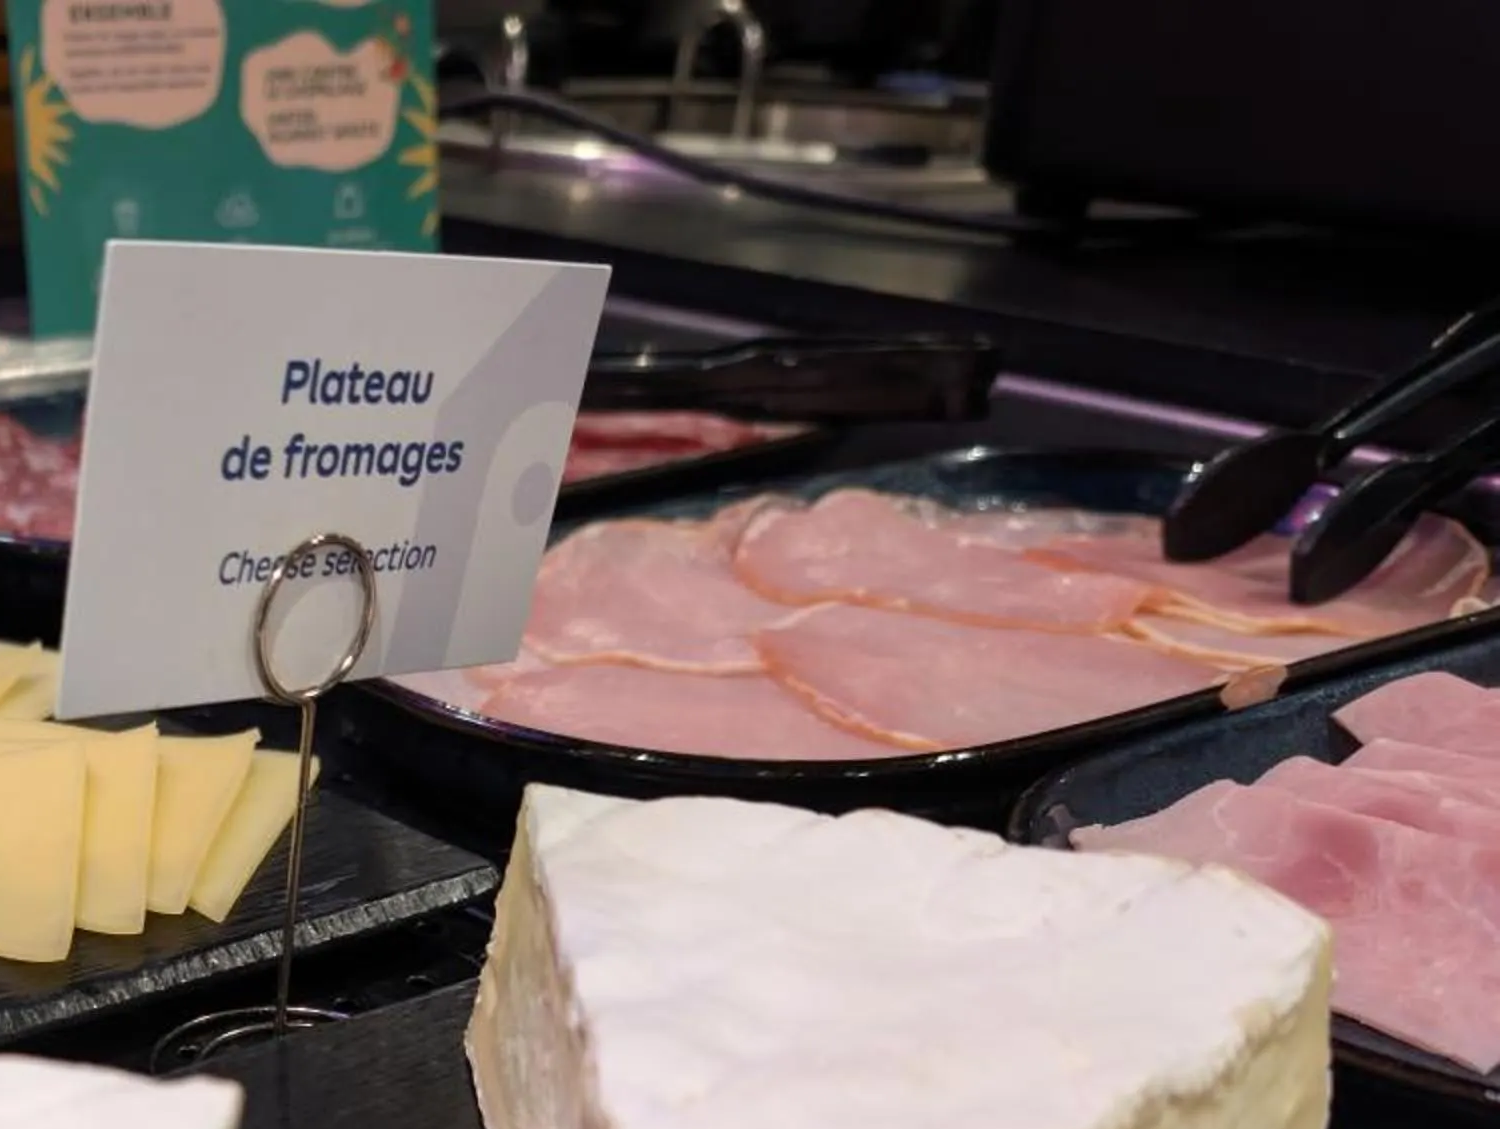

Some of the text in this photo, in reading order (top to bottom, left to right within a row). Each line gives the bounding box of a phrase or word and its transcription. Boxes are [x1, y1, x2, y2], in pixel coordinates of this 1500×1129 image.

[281, 358, 435, 405] Plateau
[221, 433, 465, 487] de fromages
